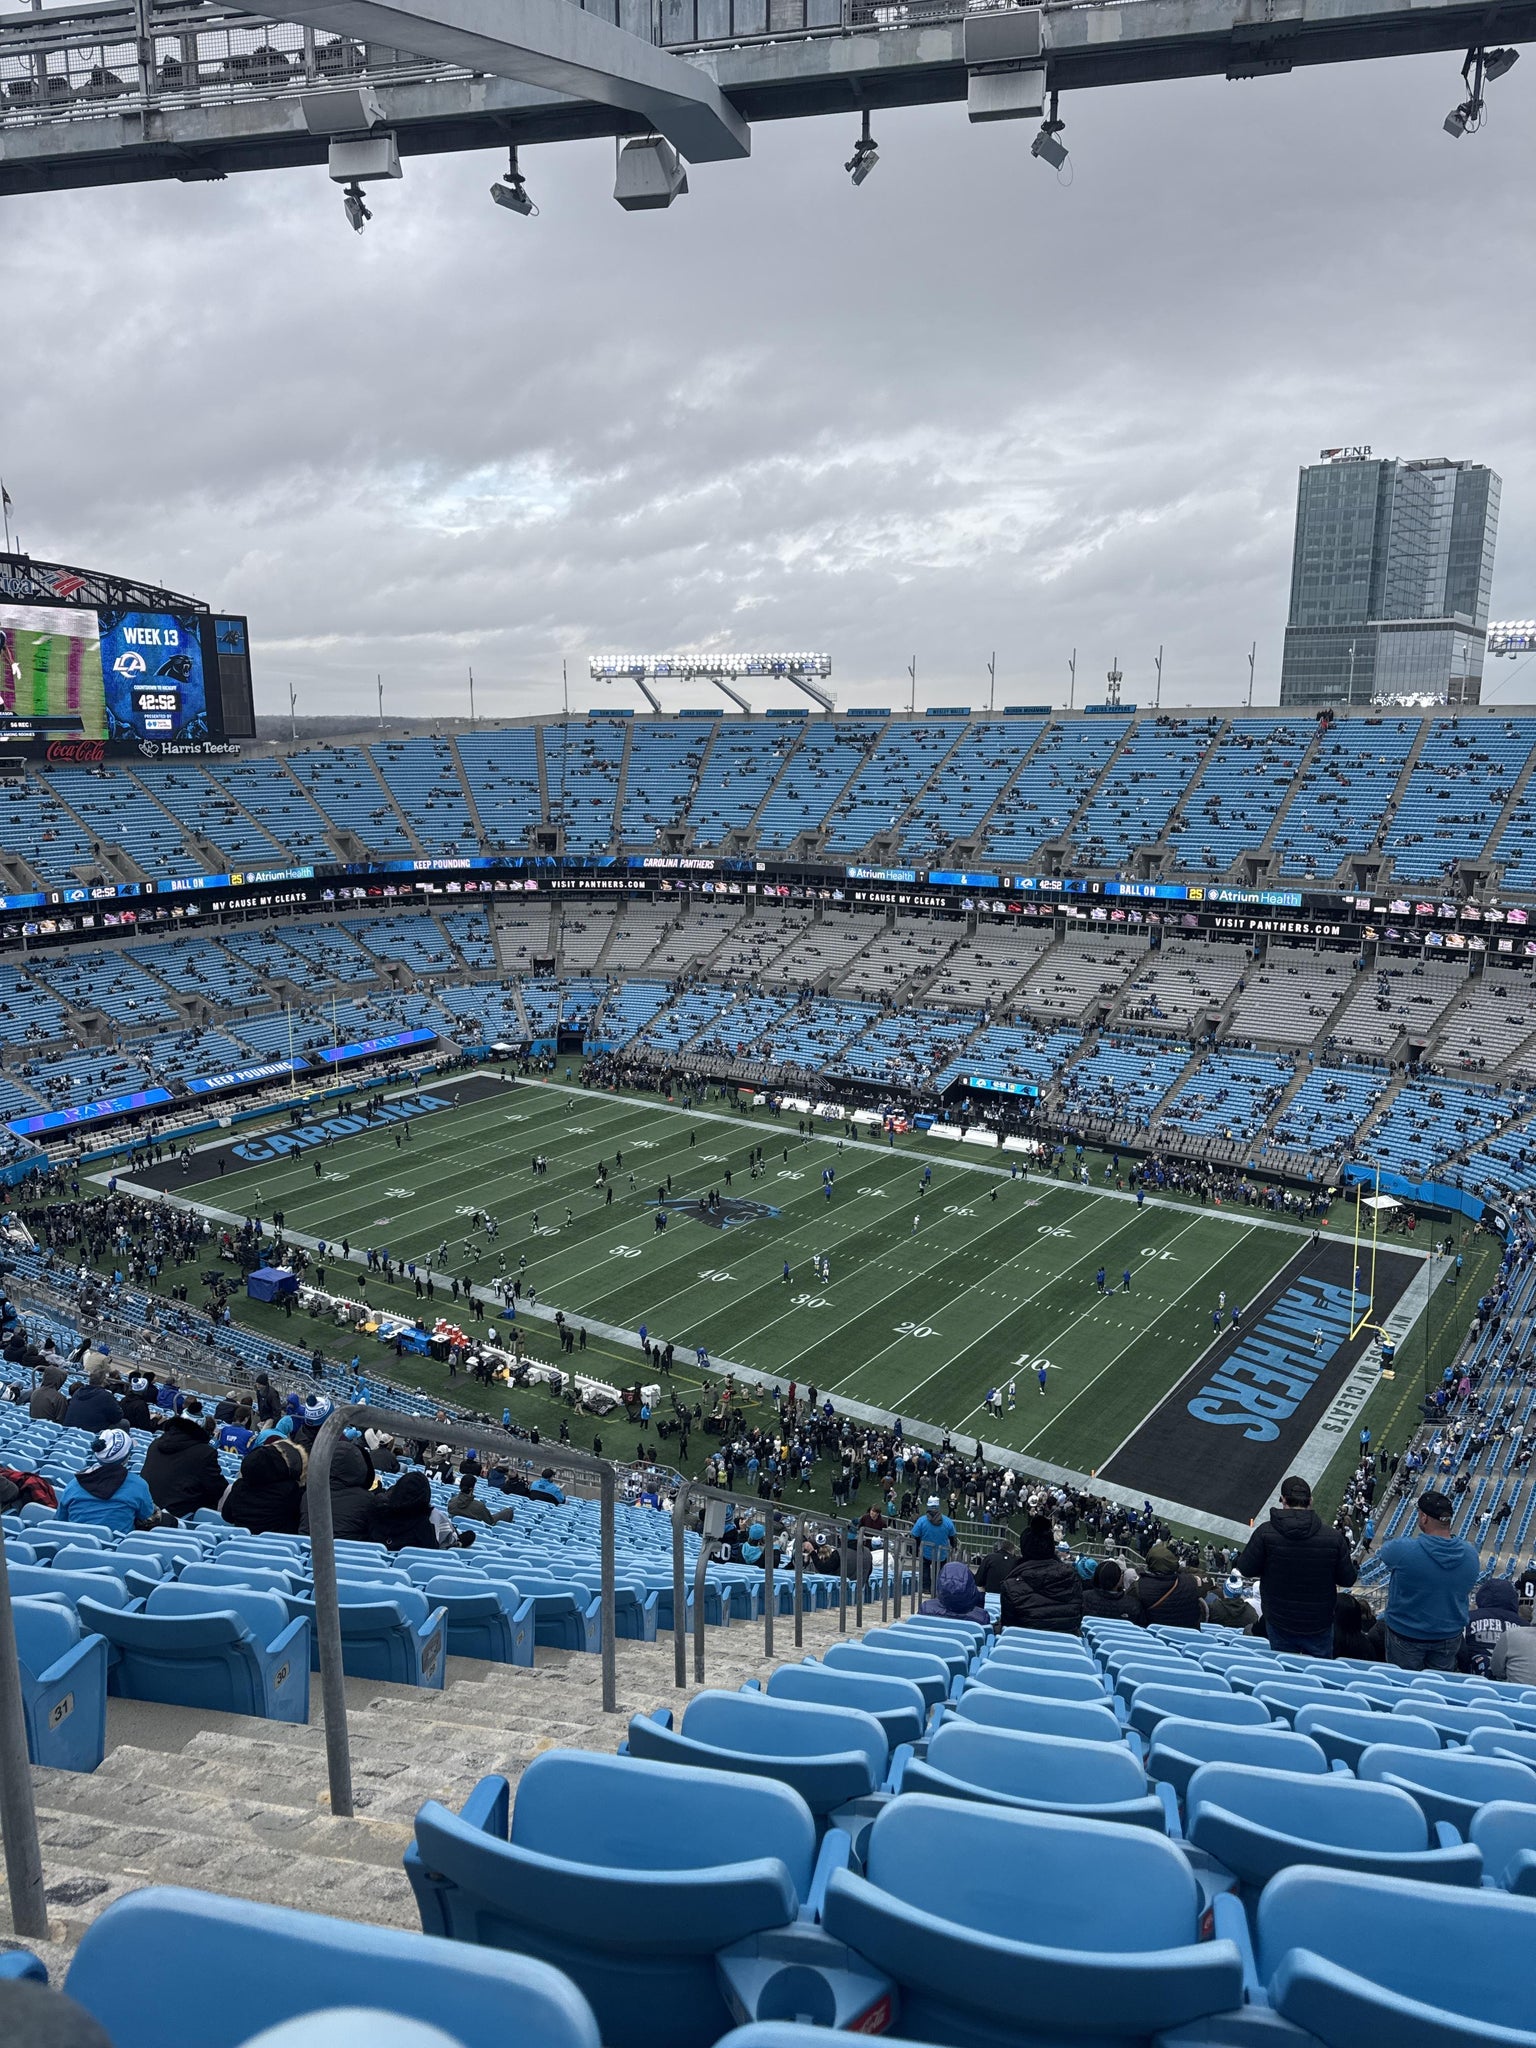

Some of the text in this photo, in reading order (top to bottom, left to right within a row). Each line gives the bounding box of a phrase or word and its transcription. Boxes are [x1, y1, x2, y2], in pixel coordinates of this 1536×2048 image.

[123, 627, 179, 646] WEEK 13
[138, 694, 177, 710] 42:52
[161, 742, 241, 754] Harris Teeter
[413, 858, 471, 869] KEEP POUNDING
[643, 858, 715, 869] CAROLINA PANTHERS
[231, 874, 243, 884] 25
[255, 867, 313, 882] Atrium Health
[856, 868, 913, 881] Atrium Health
[171, 878, 204, 890] BALL ON
[551, 880, 645, 889] VISIT PANTHERS.COM
[1039, 880, 1062, 890] 42:52
[1119, 884, 1156, 896] BALL ON
[91, 887, 116, 898] 42:52
[855, 892, 946, 906] MY CAUSE MY CLEATS
[1189, 888, 1203, 899] 25
[1218, 889, 1299, 905] Atrium Health
[212, 893, 307, 911] MY CAUSE MY CLEATS
[1215, 917, 1340, 936] VISIT PANTHERS.COM
[205, 1062, 293, 1088] KEEP POUNDING
[232, 1094, 454, 1161] CAROLINA
[609, 1245, 642, 1258] 50
[696, 1269, 730, 1281] 40
[790, 1293, 827, 1308] 30
[892, 1321, 933, 1338] 20
[1010, 1353, 1051, 1371] 10
[1187, 1275, 1371, 1442] PANTHERS
[1321, 1314, 1412, 1434] MY CSE MY CLEATS
[1470, 1618, 1503, 1635] SUPER
[277, 1667, 287, 1685] 30
[54, 1700, 69, 1722] 31
